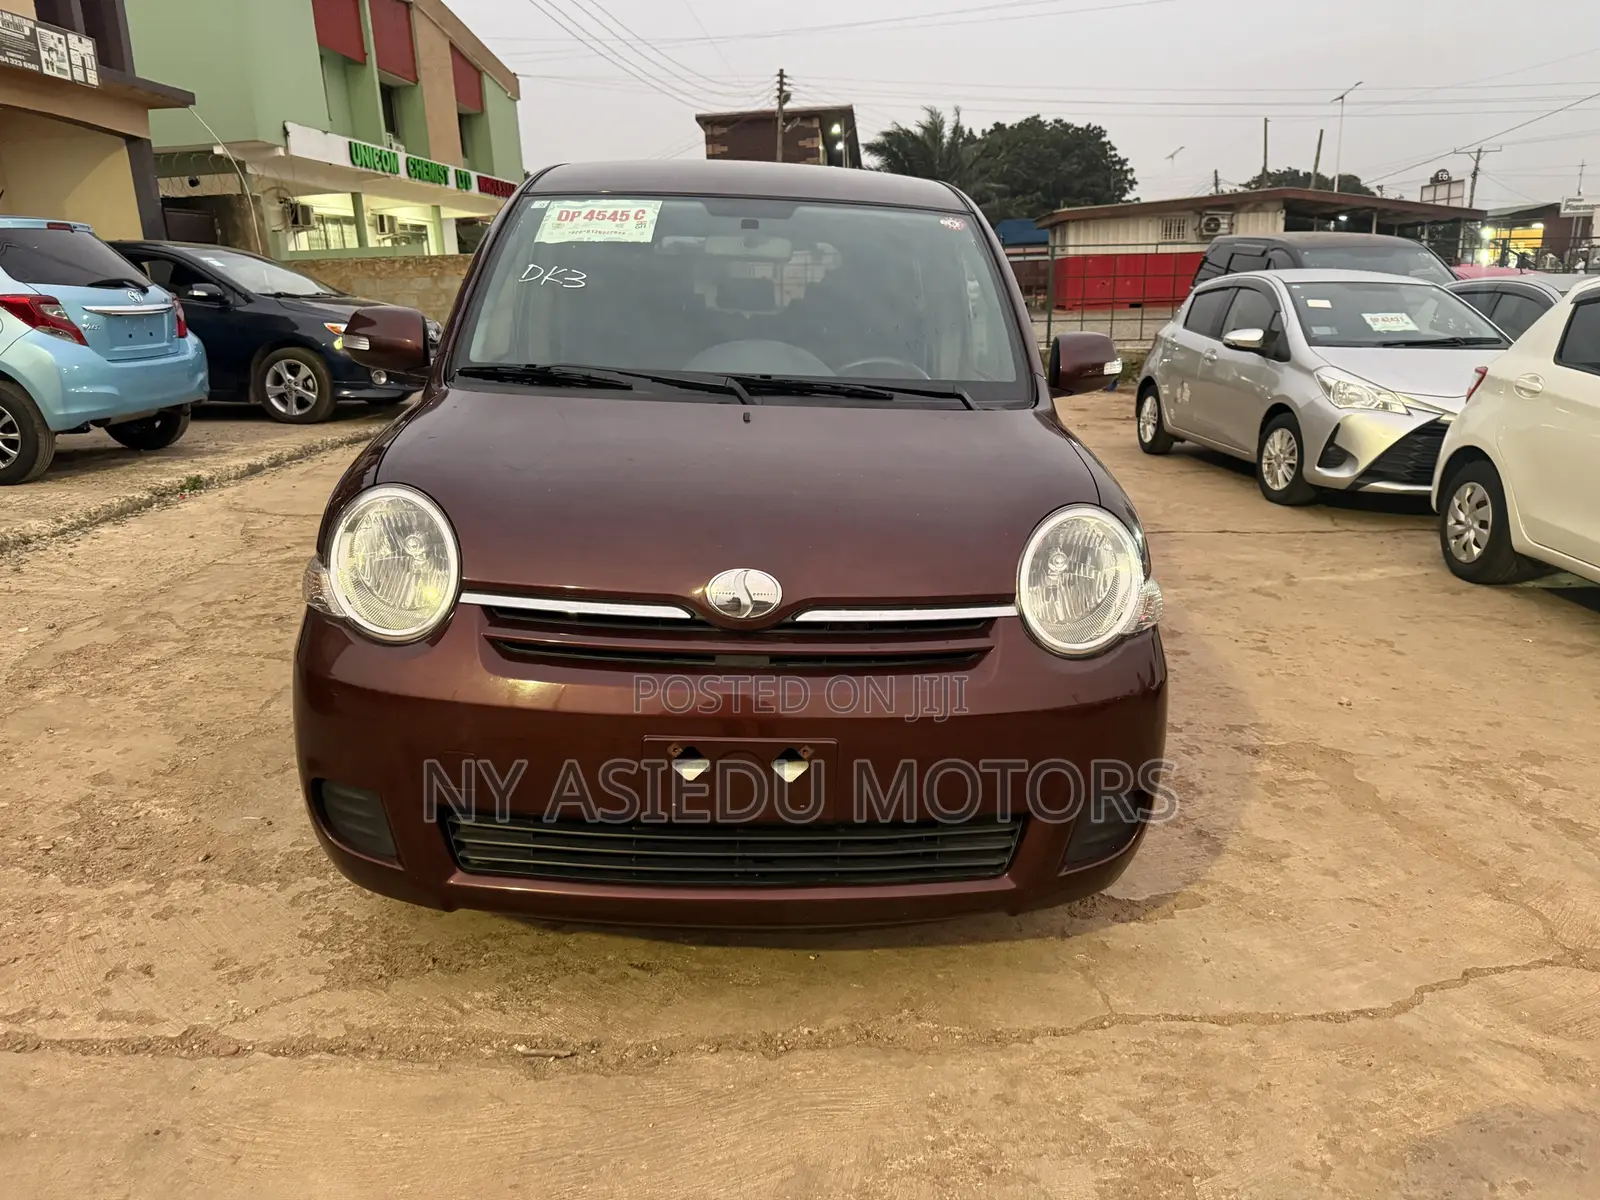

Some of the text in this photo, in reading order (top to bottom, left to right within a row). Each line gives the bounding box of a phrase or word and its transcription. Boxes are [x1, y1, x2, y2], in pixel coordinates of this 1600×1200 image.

[406, 156, 450, 186] CHEMIST
[455, 169, 472, 191] LTD
[557, 208, 646, 222] DP 4545 C
[519, 263, 587, 288] DK3
